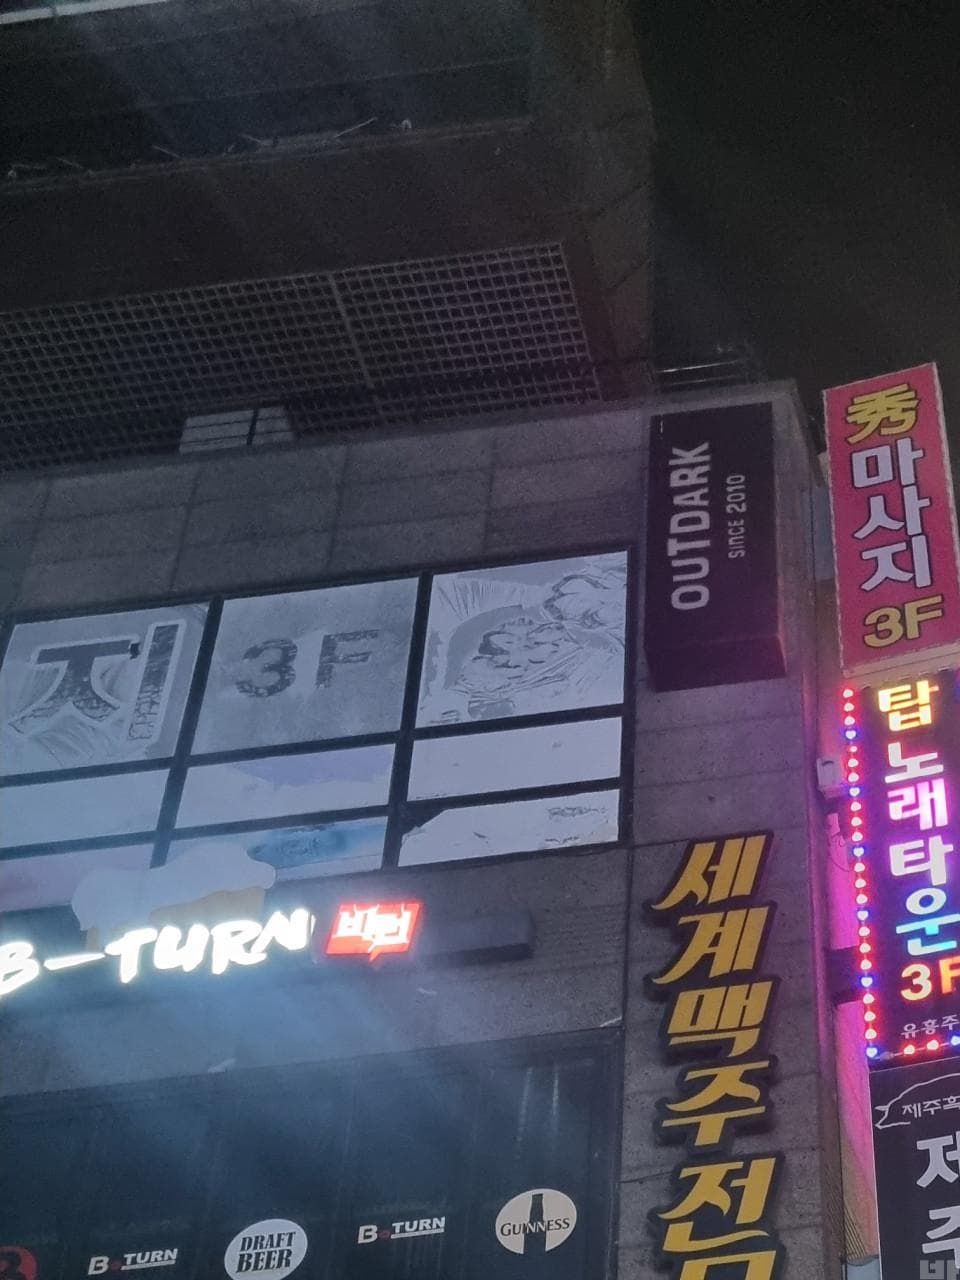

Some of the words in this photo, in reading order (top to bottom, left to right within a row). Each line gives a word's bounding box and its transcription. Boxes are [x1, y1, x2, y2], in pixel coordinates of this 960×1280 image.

[845, 383, 919, 444] 秀
[725, 474, 747, 514] 2010
[851, 437, 932, 592] 마사지
[667, 441, 712, 611] OUTDARK
[862, 595, 945, 649] 3F
[8, 622, 180, 741] 지
[236, 628, 380, 699] 3F
[878, 680, 939, 732] 탑
[884, 741, 960, 957] 노래타운
[240, 1231, 297, 1252] DRAFT
[357, 1224, 379, 1245] B
[391, 1216, 446, 1234] TURN
[499, 1217, 571, 1238] GUINNESS
[87, 1255, 110, 1276] B
[123, 1248, 179, 1263] TURN
[236, 1248, 294, 1274] BEER
